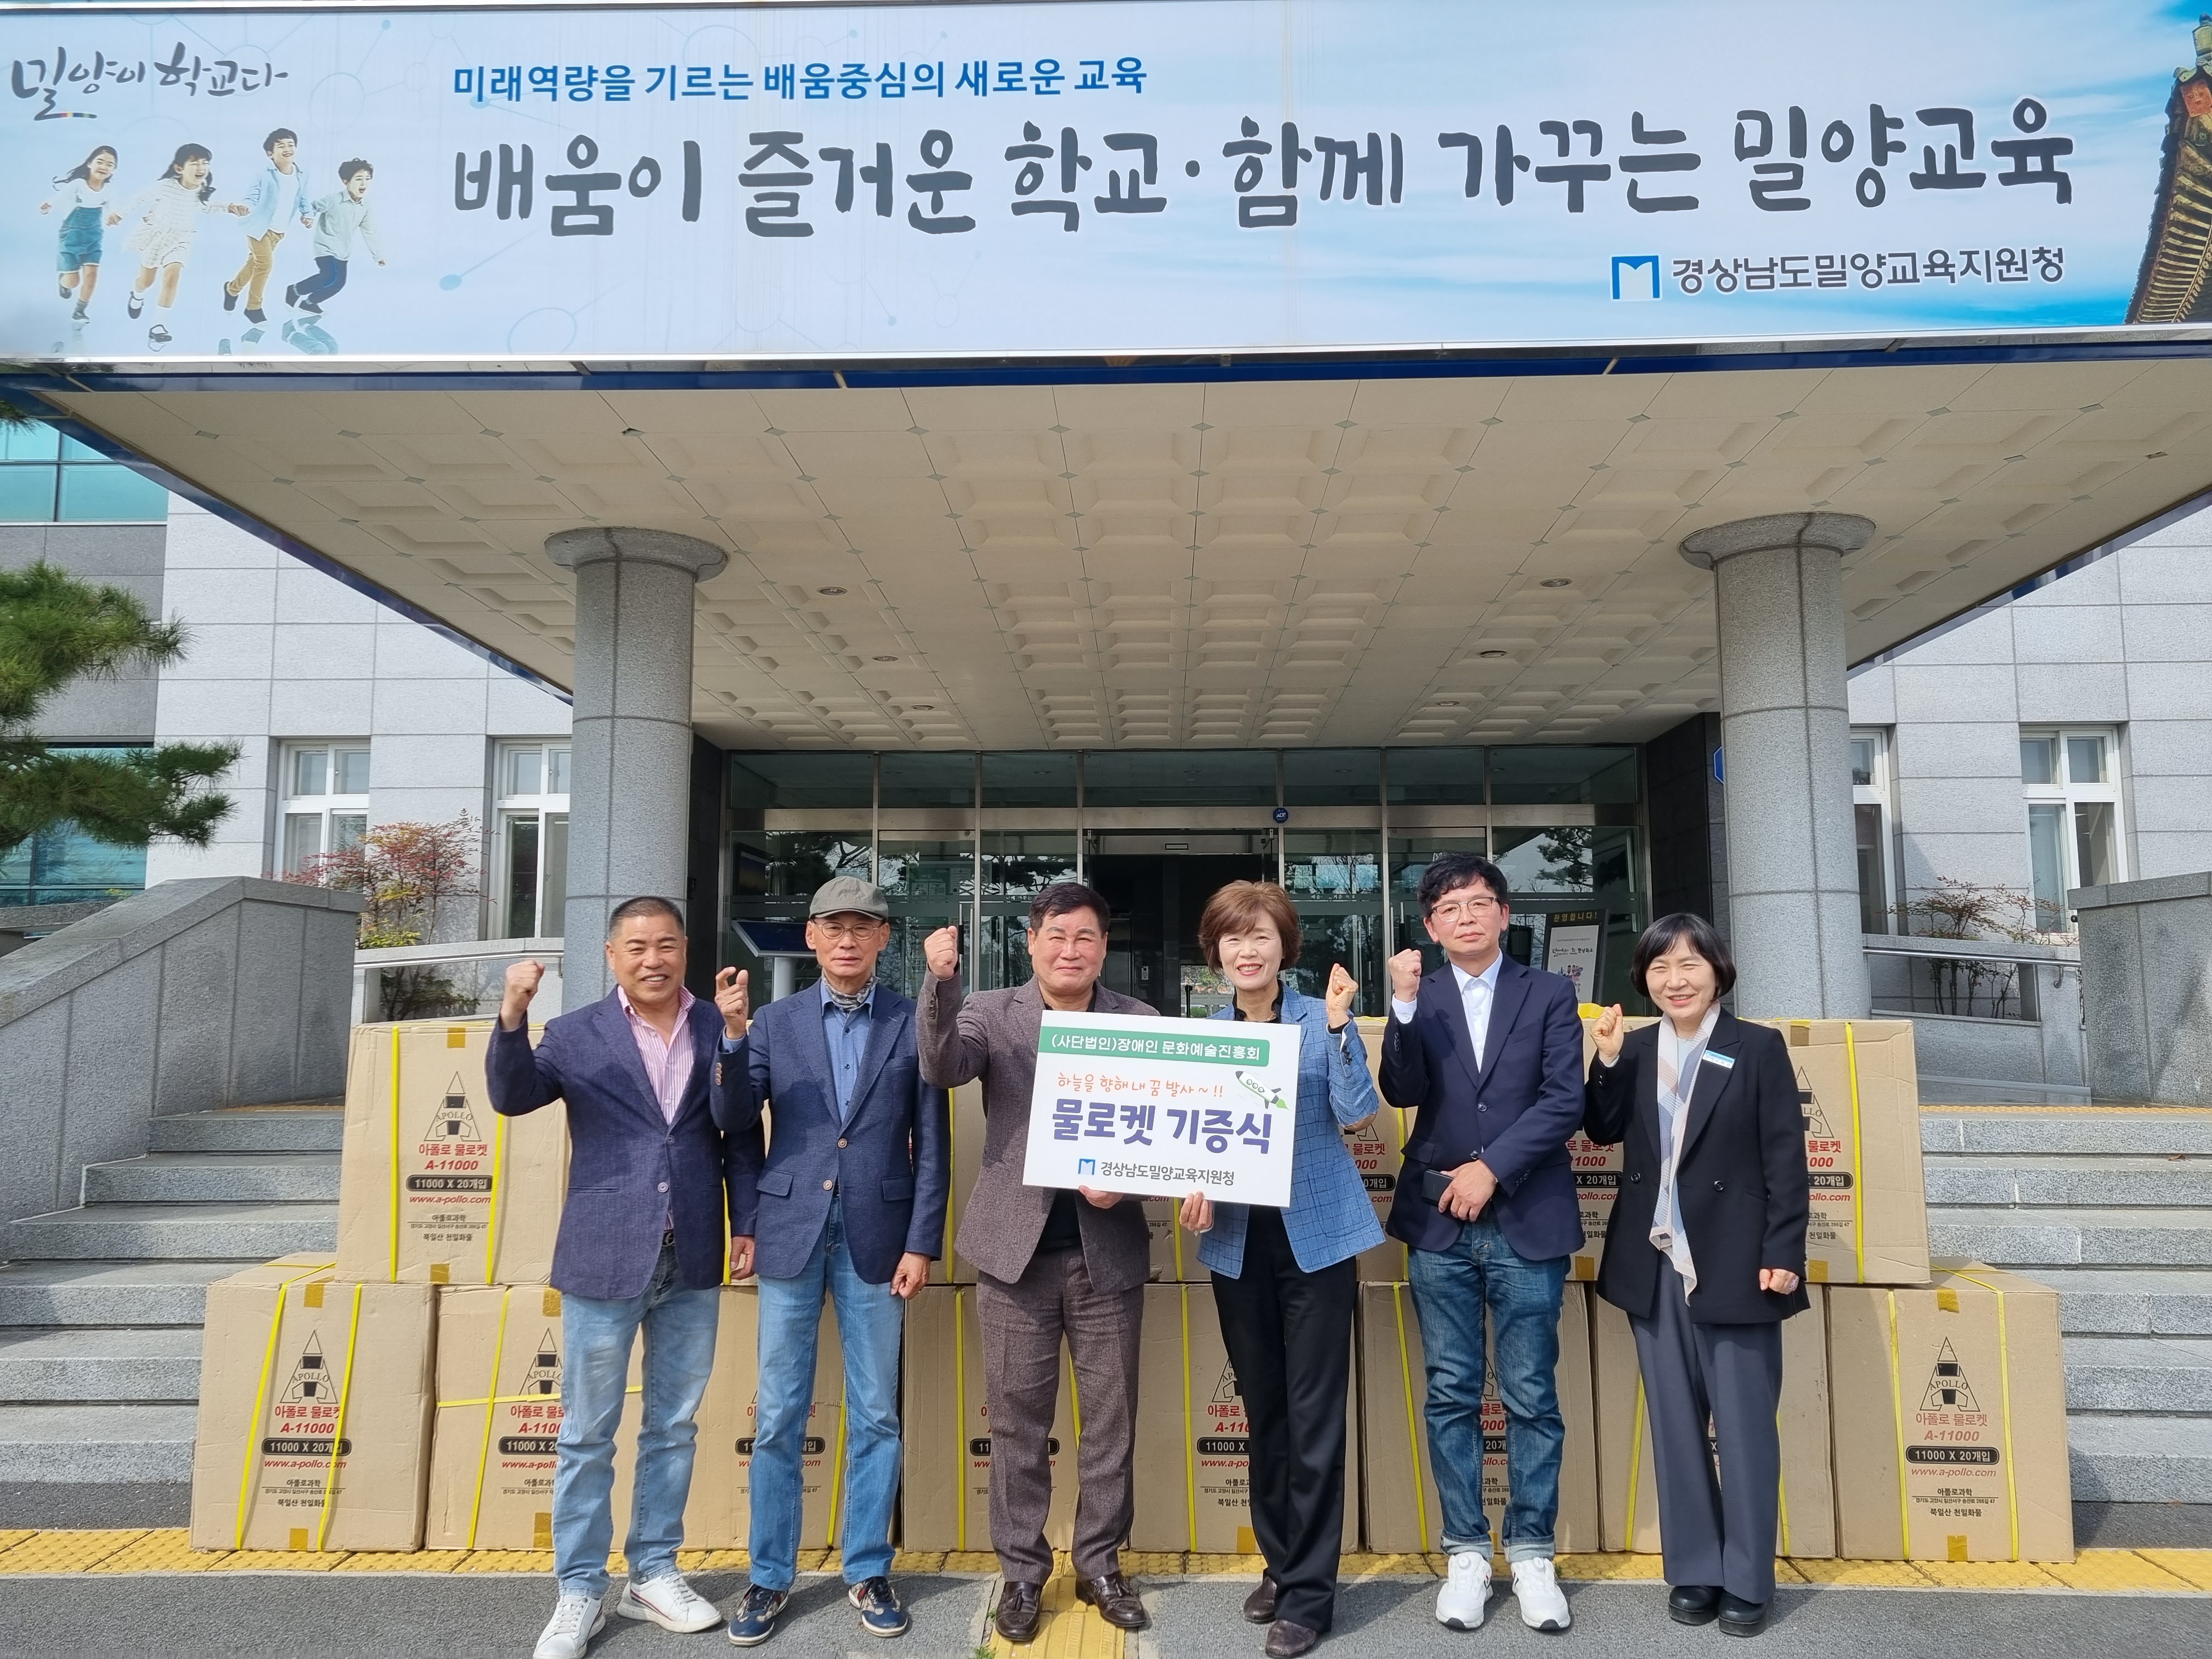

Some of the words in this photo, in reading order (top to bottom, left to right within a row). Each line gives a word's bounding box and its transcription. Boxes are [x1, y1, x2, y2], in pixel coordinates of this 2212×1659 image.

[453, 64, 636, 102] 미래역량을
[645, 64, 754, 102] 기르는
[764, 60, 944, 101] 배움중심의
[955, 59, 1066, 95] 새로운
[1074, 55, 1148, 94] 교육
[455, 134, 702, 238] 배움이
[738, 128, 977, 238] 즐거운
[1438, 102, 1702, 215] 가꾸는
[1734, 97, 2074, 212] 밀양교육
[1671, 246, 2066, 294] 경상남도밀양교육지원청
[1051, 1034, 1158, 1055] (사단법인)장애인
[1162, 1040, 1260, 1061] 문화예술진흥회
[1057, 1071, 1094, 1092] 하늘을
[1149, 1079, 1162, 1097] 꿈
[1165, 1080, 1194, 1098] 발사
[436, 1111, 473, 1122] APOLLO
[1052, 1098, 1156, 1146] 물로켓
[1166, 1108, 1272, 1154] 기증식
[419, 1144, 451, 1156] 아폴로
[454, 1144, 488, 1157] 물로켓
[1352, 1143, 1386, 1156] 물로켓
[1808, 1141, 1841, 1153] 물로켓
[424, 1159, 479, 1171] A-11000
[1101, 1161, 1235, 1187] 경상남도밀양교육지원청
[415, 1178, 445, 1189] 11000
[457, 1178, 488, 1190] 20개입
[1364, 1178, 1387, 1189] 0개입
[1576, 1175, 1583, 1184] X
[1587, 1175, 1616, 1186] 20개입
[1814, 1176, 1844, 1187] 20개입
[409, 1195, 491, 1205] www.a-pollo.com
[292, 1373, 330, 1384] APOLLO
[1930, 1379, 1968, 1391] APOLLO
[274, 1406, 307, 1419] 아폴로
[510, 1405, 543, 1418] 아폴로
[1207, 1404, 1240, 1418] 아폴로
[1916, 1413, 1950, 1426] 아폴로
[1953, 1413, 1988, 1427] 물로켓
[280, 1423, 335, 1434] A-11000
[1924, 1430, 1979, 1442] A-11000
[270, 1442, 299, 1453] 11000
[506, 1441, 536, 1452] 11000
[1206, 1441, 1233, 1452] 11000
[1237, 1441, 1245, 1452] X
[1486, 1440, 1506, 1451] 20개
[1915, 1450, 1945, 1460] 11000
[1949, 1451, 1956, 1460] X
[1959, 1451, 1990, 1463] 20개입
[1911, 1467, 1996, 1477] www.a-pollo.com
[1930, 1508, 1951, 1516] 북일산
[1954, 1508, 1982, 1517] 천일화물
